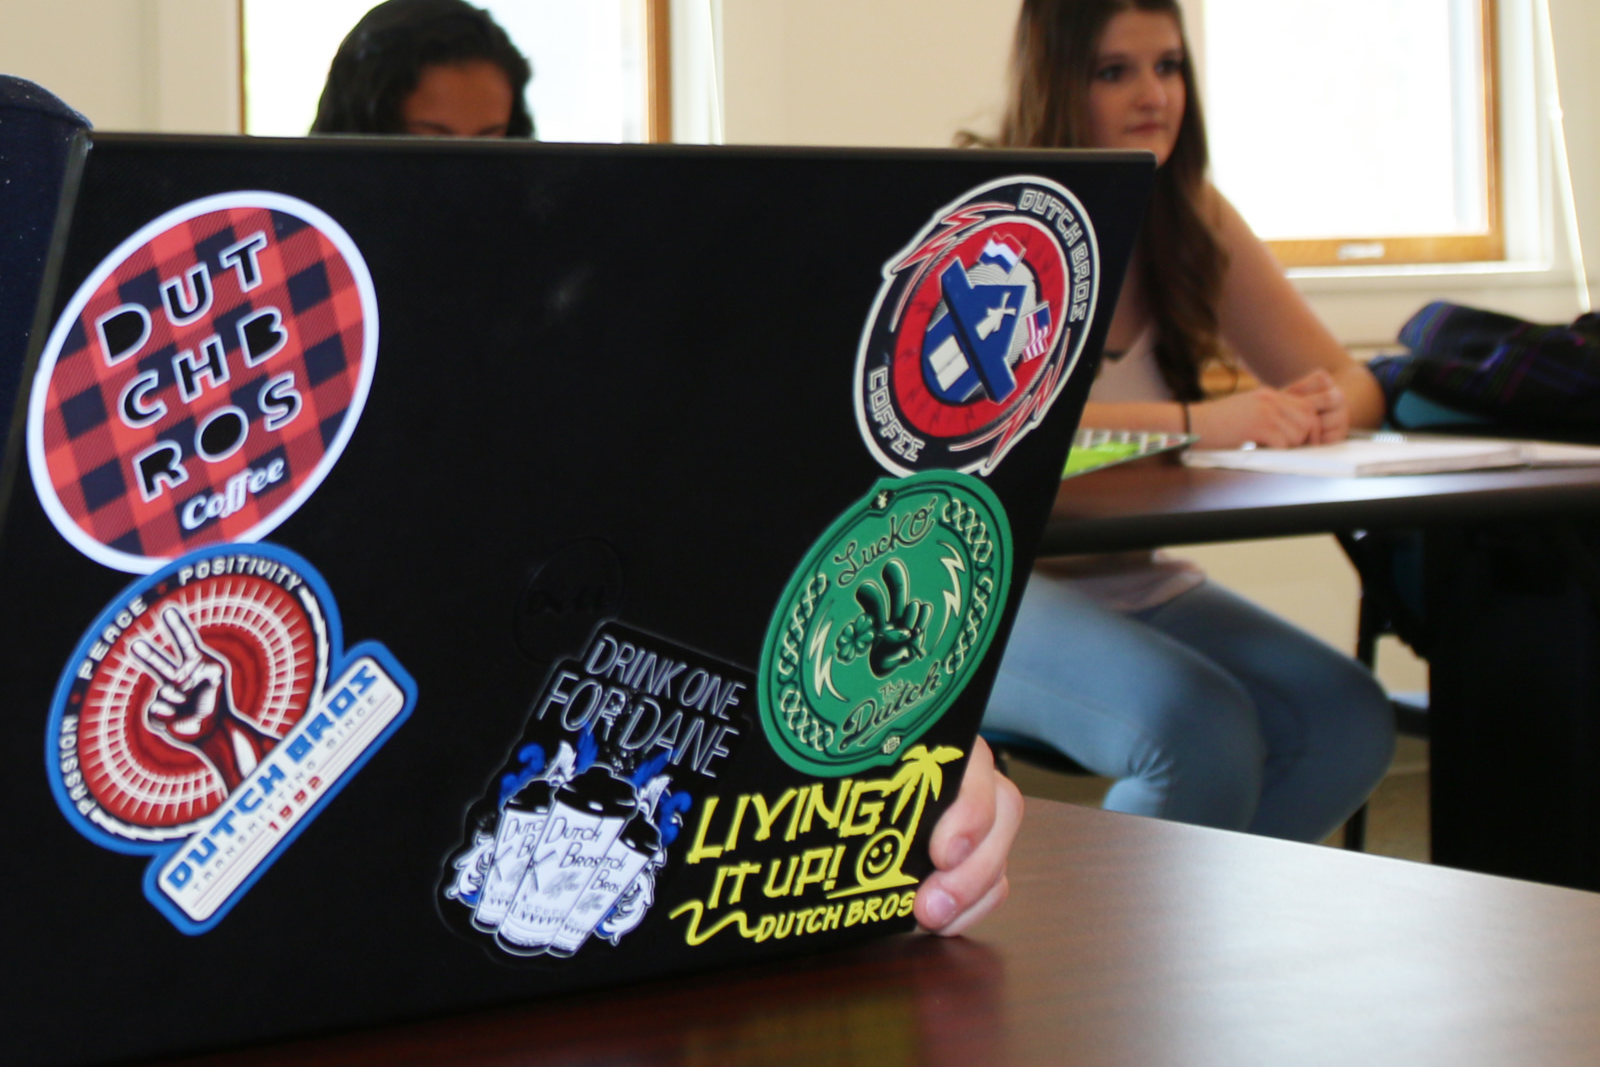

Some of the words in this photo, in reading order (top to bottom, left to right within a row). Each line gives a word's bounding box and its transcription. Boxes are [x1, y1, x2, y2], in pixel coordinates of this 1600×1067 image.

[94, 231, 268, 367] DUT
[1018, 188, 1083, 248] DUTCH
[1069, 245, 1091, 323] BROS
[118, 306, 288, 429] CHB
[869, 366, 926, 463] COFFEE
[133, 371, 303, 503] ROS
[181, 458, 285, 530] Coffee
[178, 555, 303, 591] POSITIVITY
[526, 584, 607, 617] DLL
[77, 595, 149, 680] PEACE
[585, 633, 687, 699] DRINK
[679, 669, 747, 721] ONE
[537, 670, 627, 742] FOR
[619, 697, 740, 778] DANE
[838, 660, 942, 752] Dutch
[59, 715, 96, 816] PASSION
[165, 763, 286, 892] DUTCH
[284, 665, 378, 764] BROS
[193, 761, 317, 891] TRANSMITTING
[326, 695, 378, 750] SINCE
[268, 775, 323, 832] 1992
[708, 861, 761, 909] IT
[763, 845, 846, 898] UP!
[755, 904, 843, 943] DUTCH
[844, 891, 916, 928] BROS
